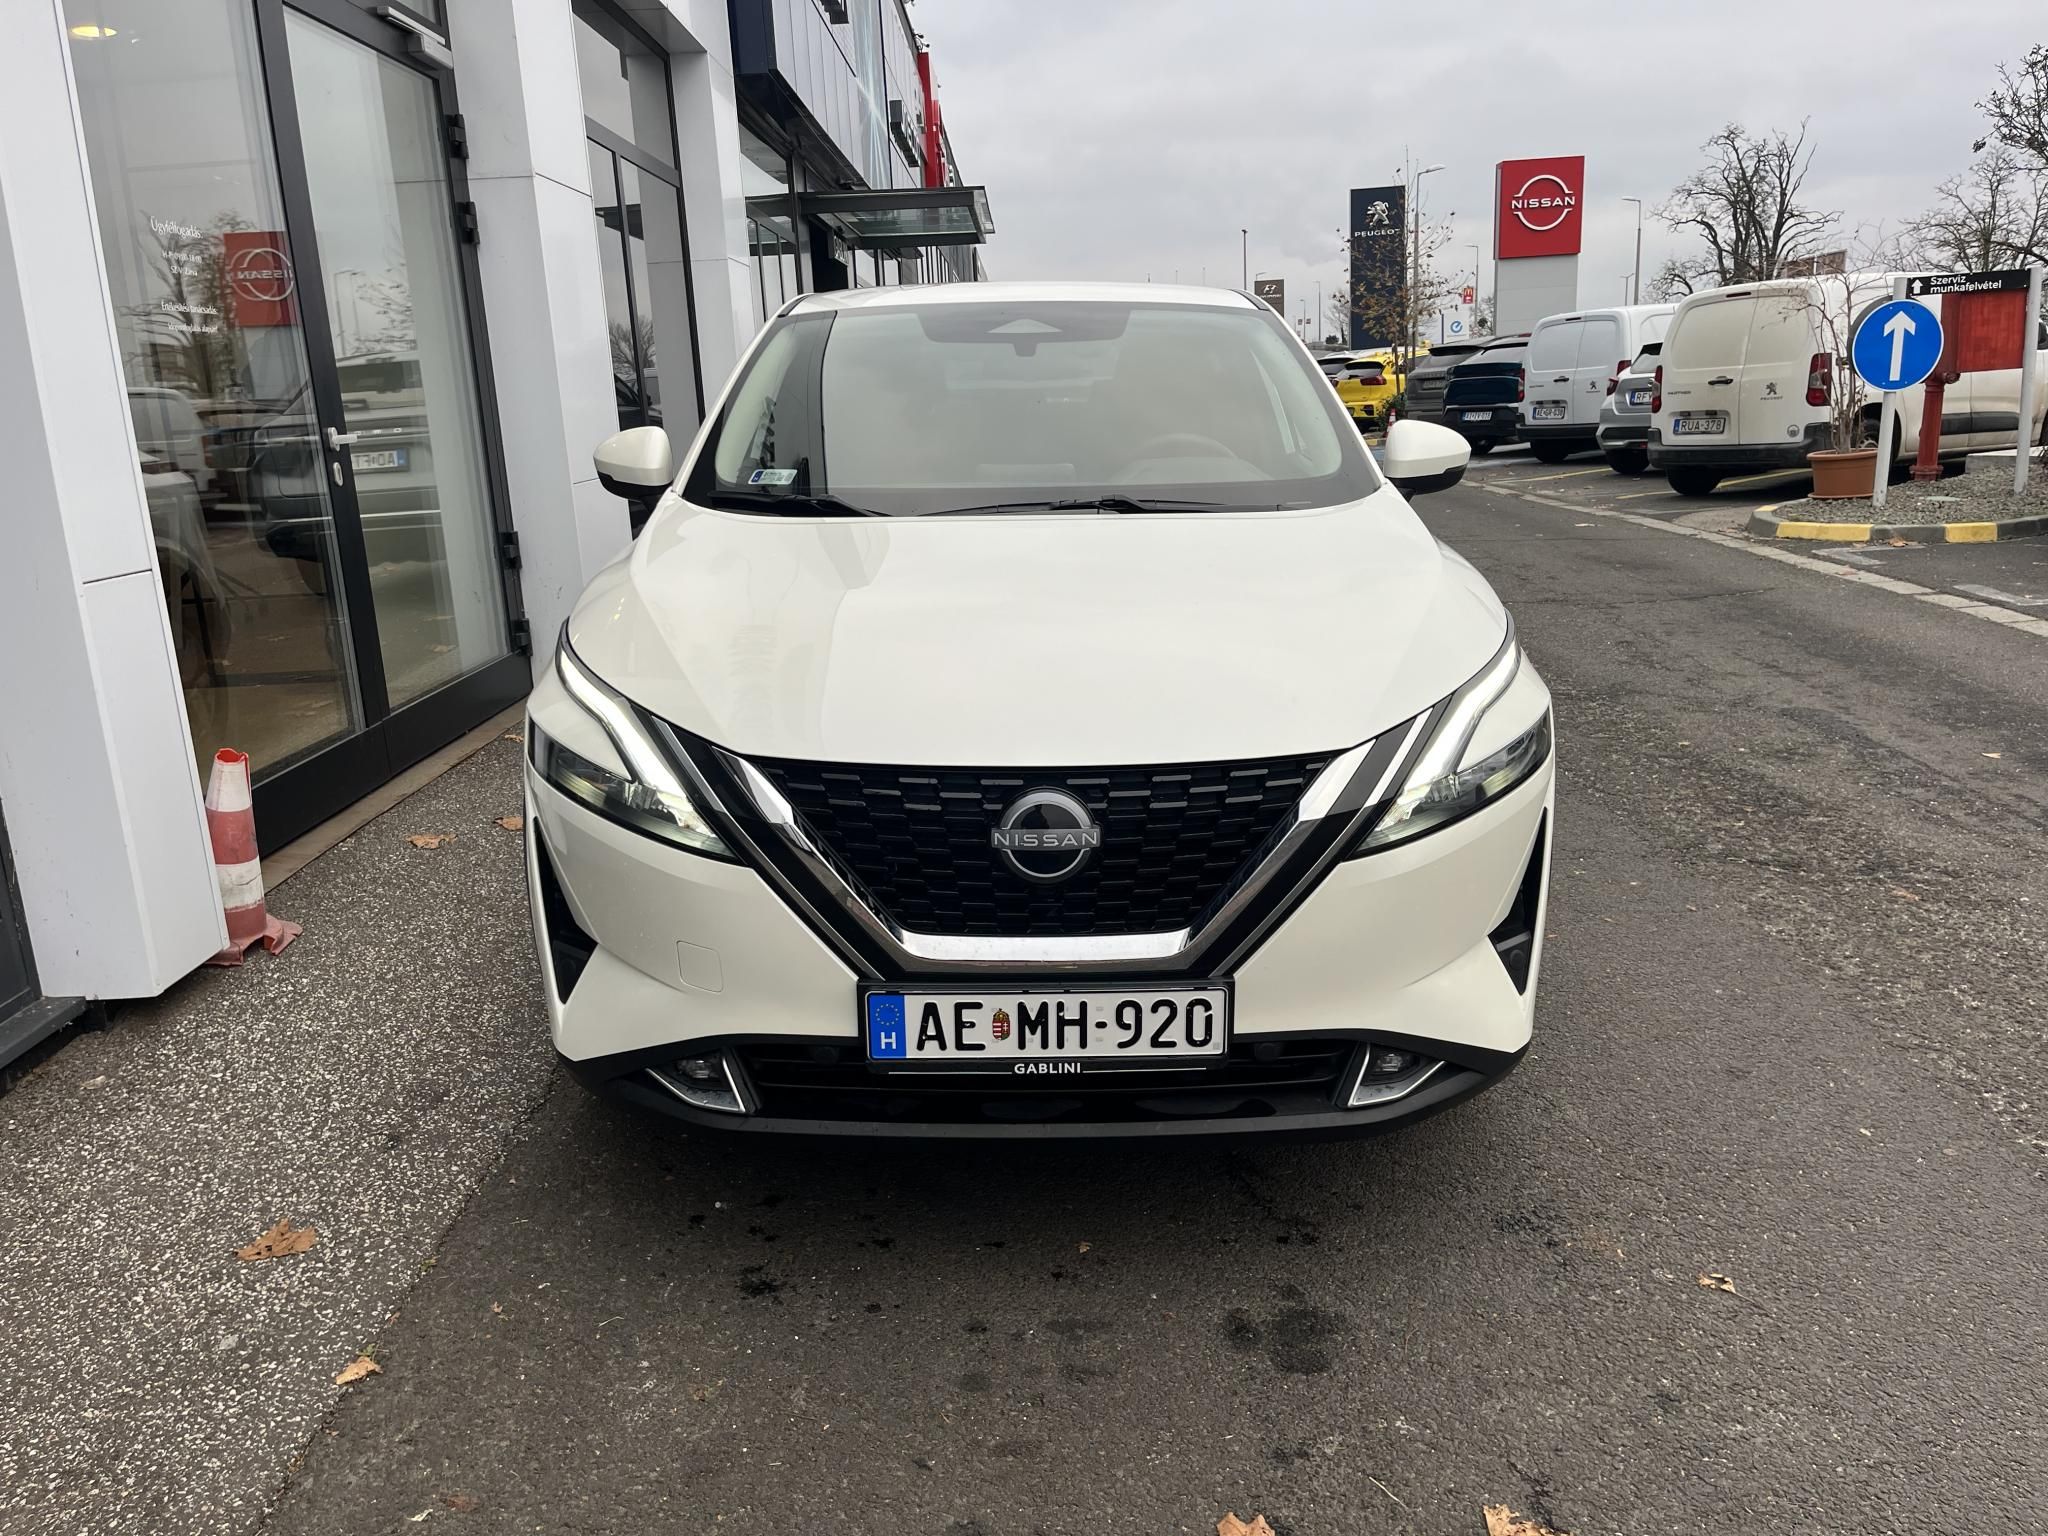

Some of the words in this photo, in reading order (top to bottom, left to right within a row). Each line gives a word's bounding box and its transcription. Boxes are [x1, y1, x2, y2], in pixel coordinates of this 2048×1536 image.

[1511, 196, 1576, 210] NISSAN
[1930, 275, 1967, 286] Szerviz
[1930, 280, 2002, 294] munkafelvétel
[1680, 419, 1722, 432] RUA-378
[994, 832, 1097, 847] NISSAN
[916, 1001, 986, 1051] AE
[1017, 998, 1213, 1050] MH-920
[879, 1031, 897, 1050] H
[1014, 1062, 1081, 1075] GABLINI
